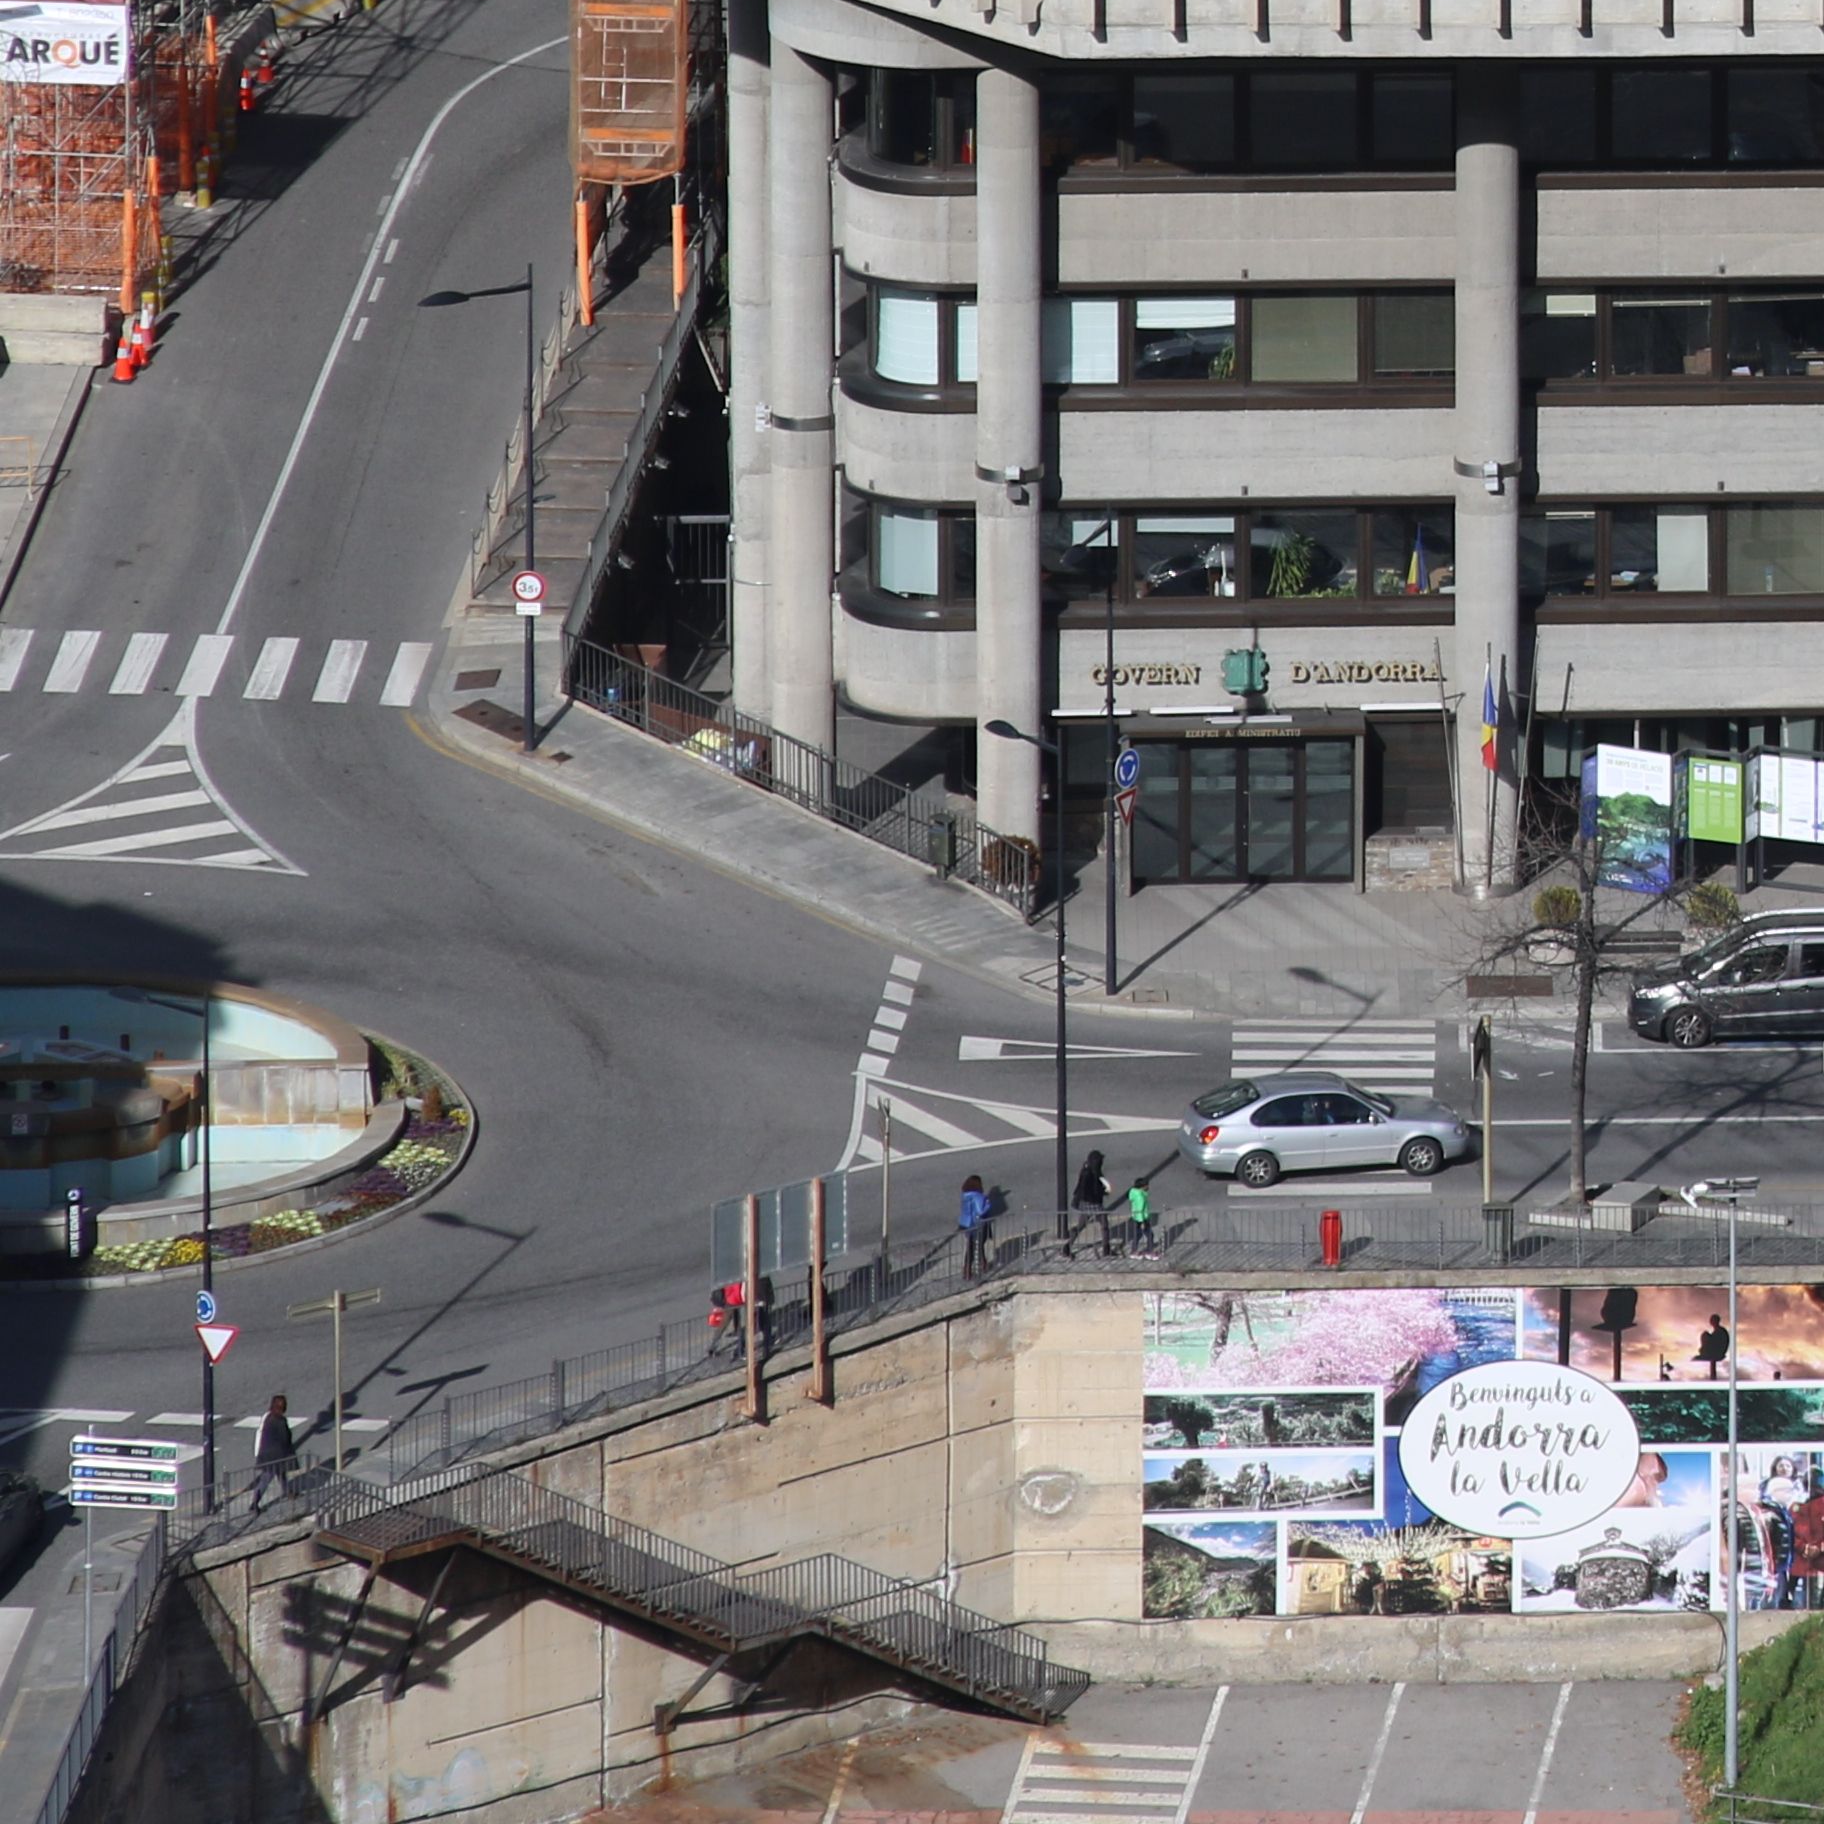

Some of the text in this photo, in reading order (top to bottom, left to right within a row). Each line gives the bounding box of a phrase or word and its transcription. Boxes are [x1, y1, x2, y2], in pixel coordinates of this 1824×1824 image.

[6, 33, 120, 69] ARQUÉ
[1092, 661, 1448, 686] GOVERN D'ANDORRA
[1450, 1377, 1597, 1411] Benvinguts a
[1430, 1406, 1611, 1464] Andorra
[1450, 1458, 1590, 1497] la Vella
